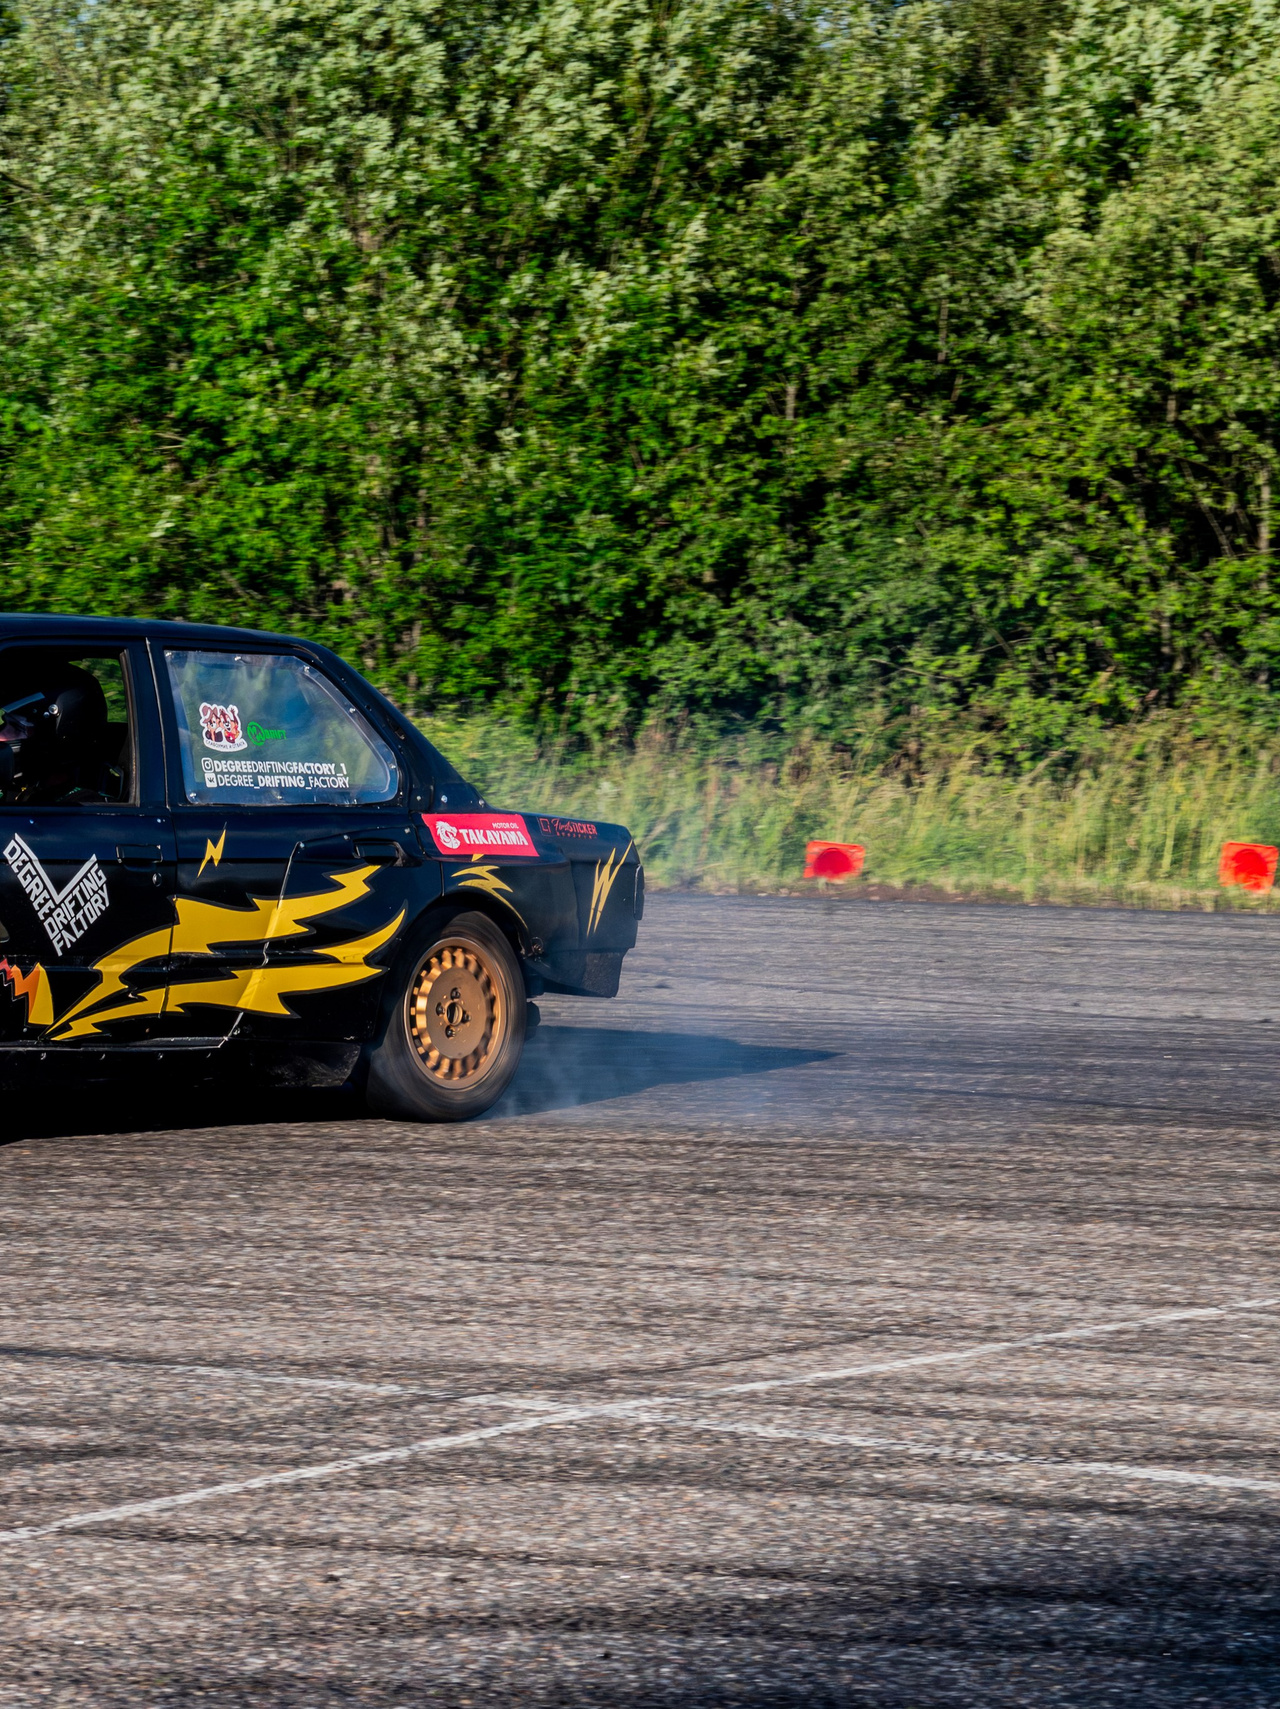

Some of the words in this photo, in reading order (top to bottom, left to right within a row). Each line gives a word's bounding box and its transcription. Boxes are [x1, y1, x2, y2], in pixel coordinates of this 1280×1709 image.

[214, 760, 347, 776] DEGREEDRIFTINGFACTORY_1
[217, 774, 349, 789] DEGREE_DRIFTING_FACTORY
[458, 828, 529, 846] TAKAYAMA
[3, 839, 56, 920] DEGREE
[43, 863, 107, 940] DRIFTING
[52, 883, 110, 957] FACTORY
